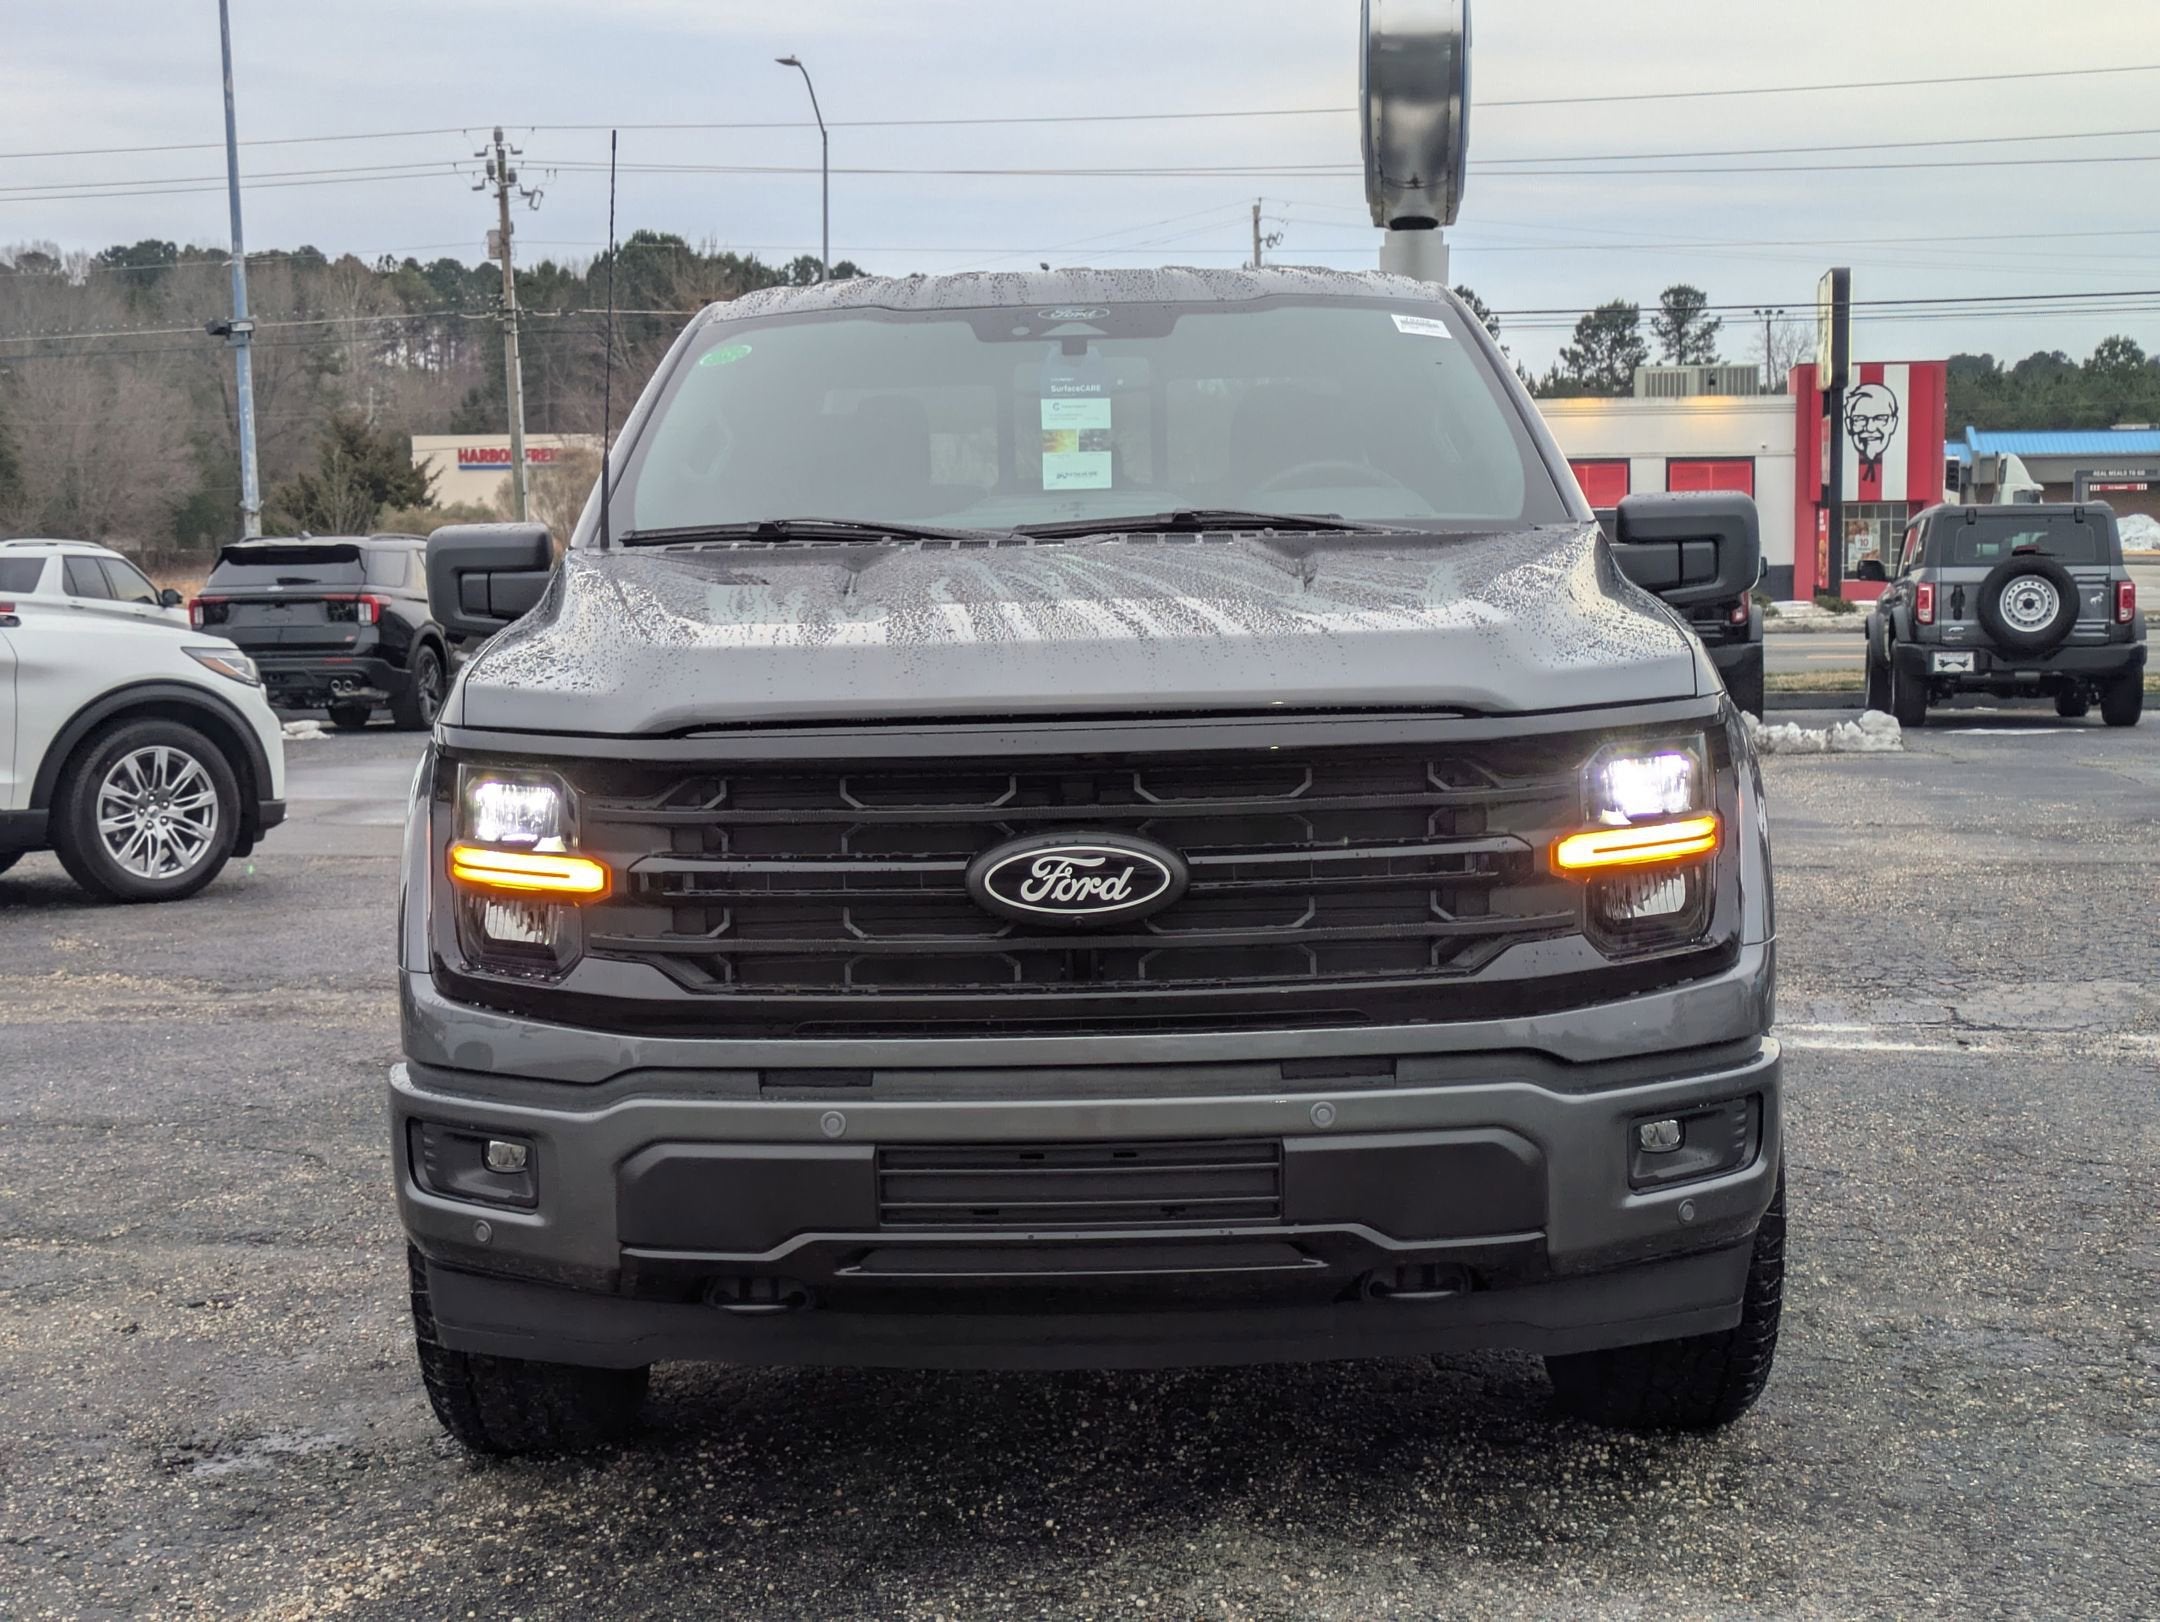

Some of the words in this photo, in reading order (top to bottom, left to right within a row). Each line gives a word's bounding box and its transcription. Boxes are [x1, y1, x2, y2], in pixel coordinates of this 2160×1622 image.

[1050, 308, 1098, 319] Ford
[1050, 384, 1102, 393] SurfaceCARE
[457, 447, 512, 463] HARBO
[1020, 855, 1135, 902] Ford
